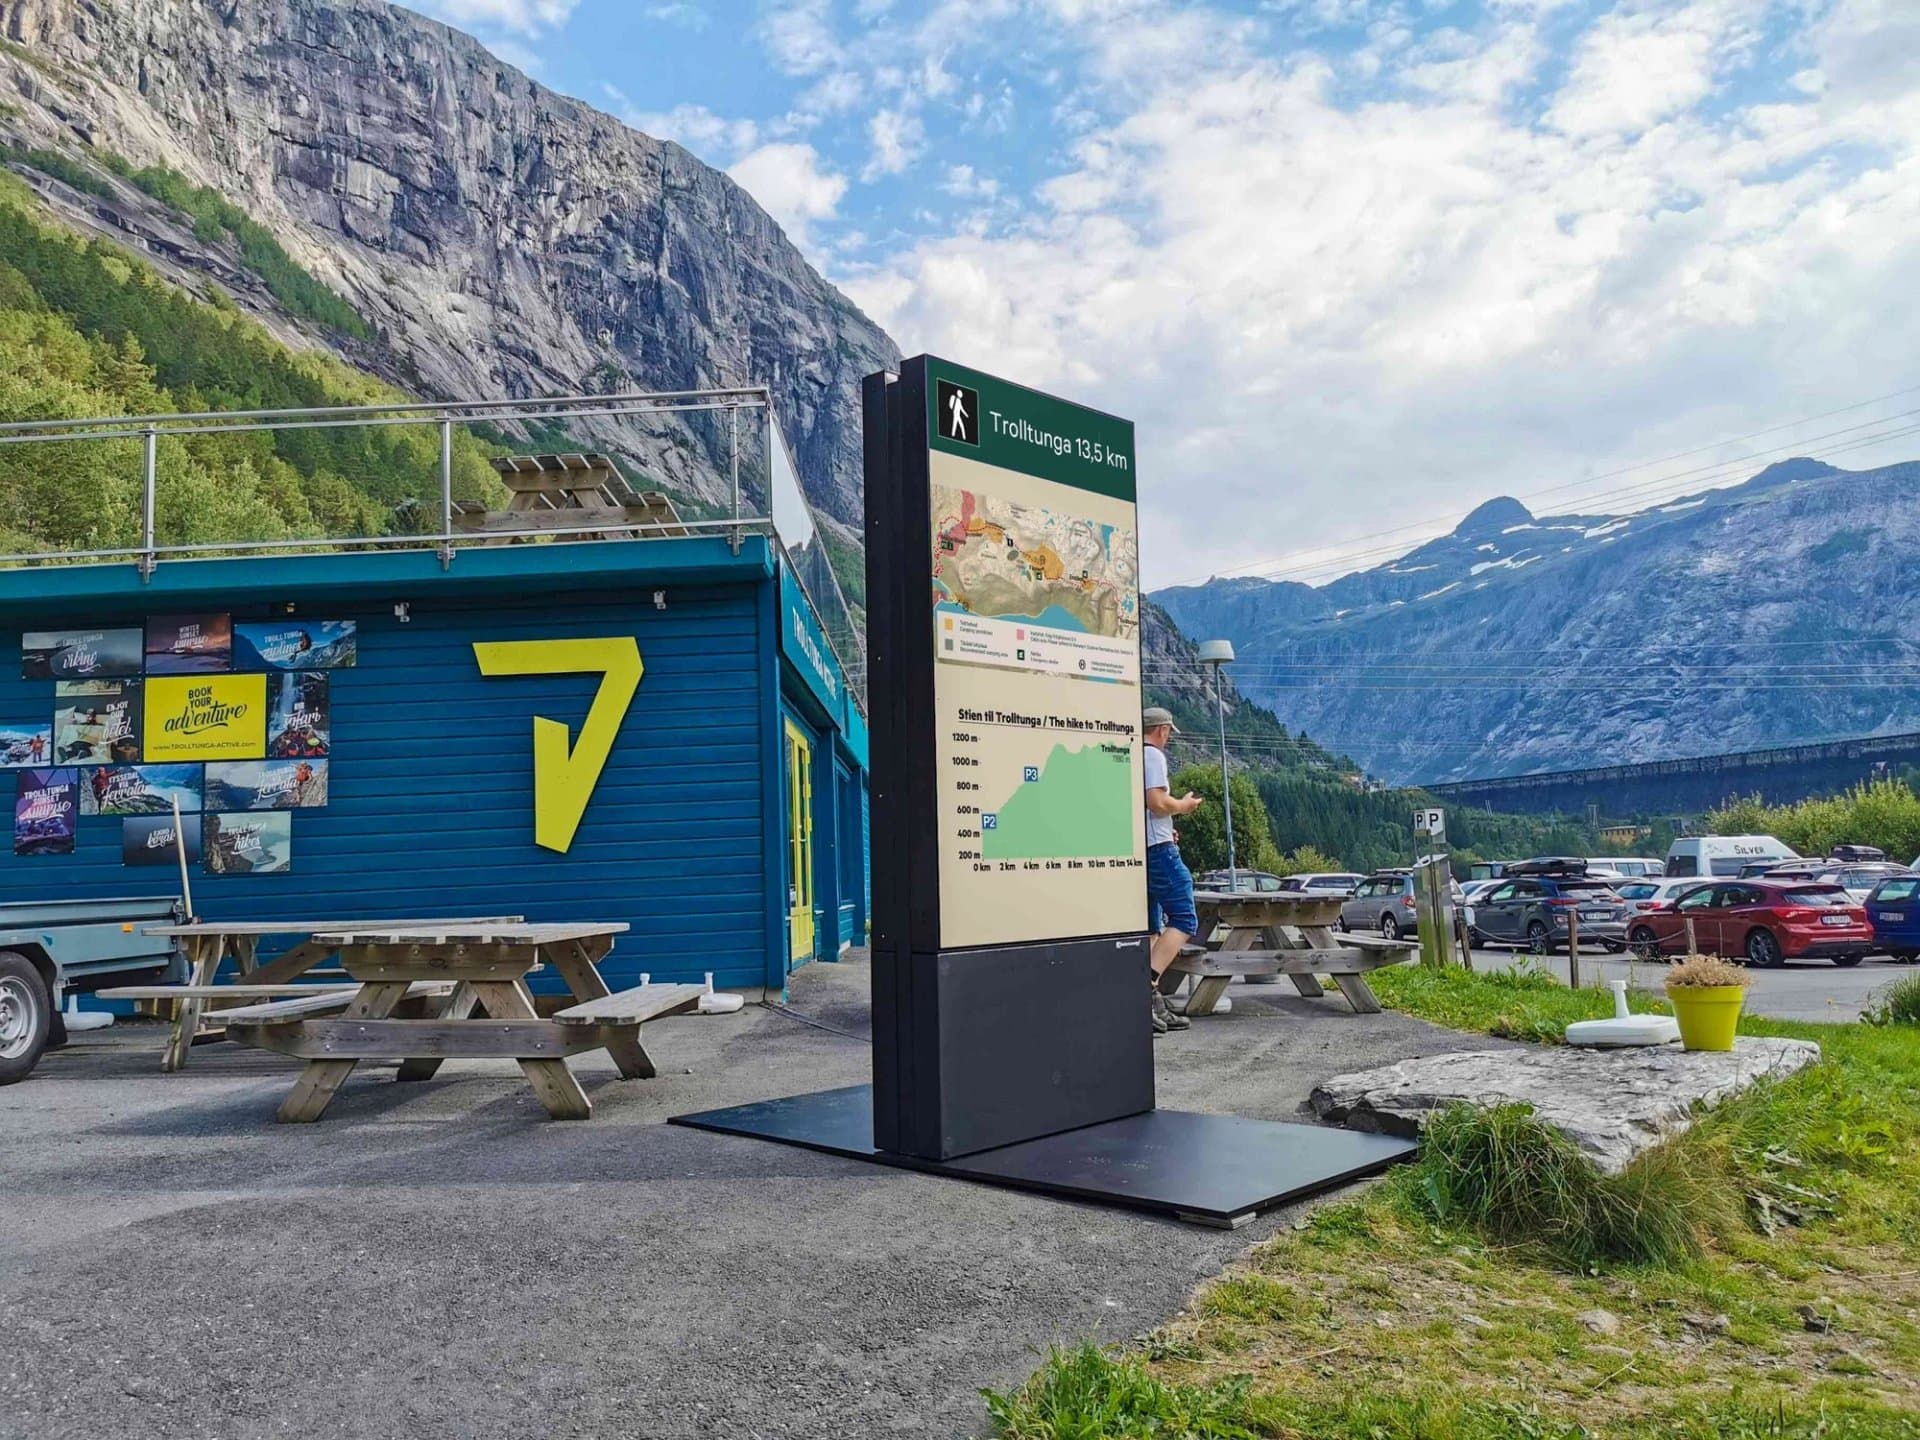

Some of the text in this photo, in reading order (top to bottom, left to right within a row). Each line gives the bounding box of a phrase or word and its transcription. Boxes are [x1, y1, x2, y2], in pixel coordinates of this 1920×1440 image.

[989, 411, 1128, 470] Trolltunga 13,5 km
[188, 686, 213, 699] BOOK
[106, 701, 129, 712] ENJOY
[190, 697, 212, 709] YOUR
[110, 710, 125, 719] OUR
[164, 700, 248, 733] adventure
[284, 706, 321, 731] safari
[958, 708, 983, 721] Stien
[984, 710, 994, 722] til
[996, 711, 1042, 728] Trolltunga
[1049, 716, 1065, 728] The
[1066, 717, 1084, 730] hike
[1085, 720, 1094, 730] to
[1095, 720, 1135, 735] Trolltunga
[102, 716, 132, 740] hotel
[952, 732, 970, 742] 1200
[952, 757, 970, 766] 1000
[1025, 768, 1038, 780] P3
[957, 781, 972, 790] 800
[24, 784, 70, 801] TROLLTUNGA
[101, 779, 147, 804] ferrata
[33, 793, 60, 805] SUNSET
[957, 805, 972, 814] 600
[983, 815, 996, 828] P2
[1416, 814, 1423, 828] P
[1429, 813, 1439, 827] P
[957, 829, 972, 838] 400
[234, 833, 261, 851] hikes
[1734, 844, 1764, 855] SILVER
[958, 851, 972, 860] 200
[980, 862, 991, 871] km
[1005, 862, 1016, 871] km
[1029, 861, 1040, 870] km
[1051, 861, 1061, 869] km
[1073, 860, 1083, 868] km
[1096, 859, 1106, 868] km
[1116, 859, 1126, 867] km
[1134, 858, 1143, 867] km
